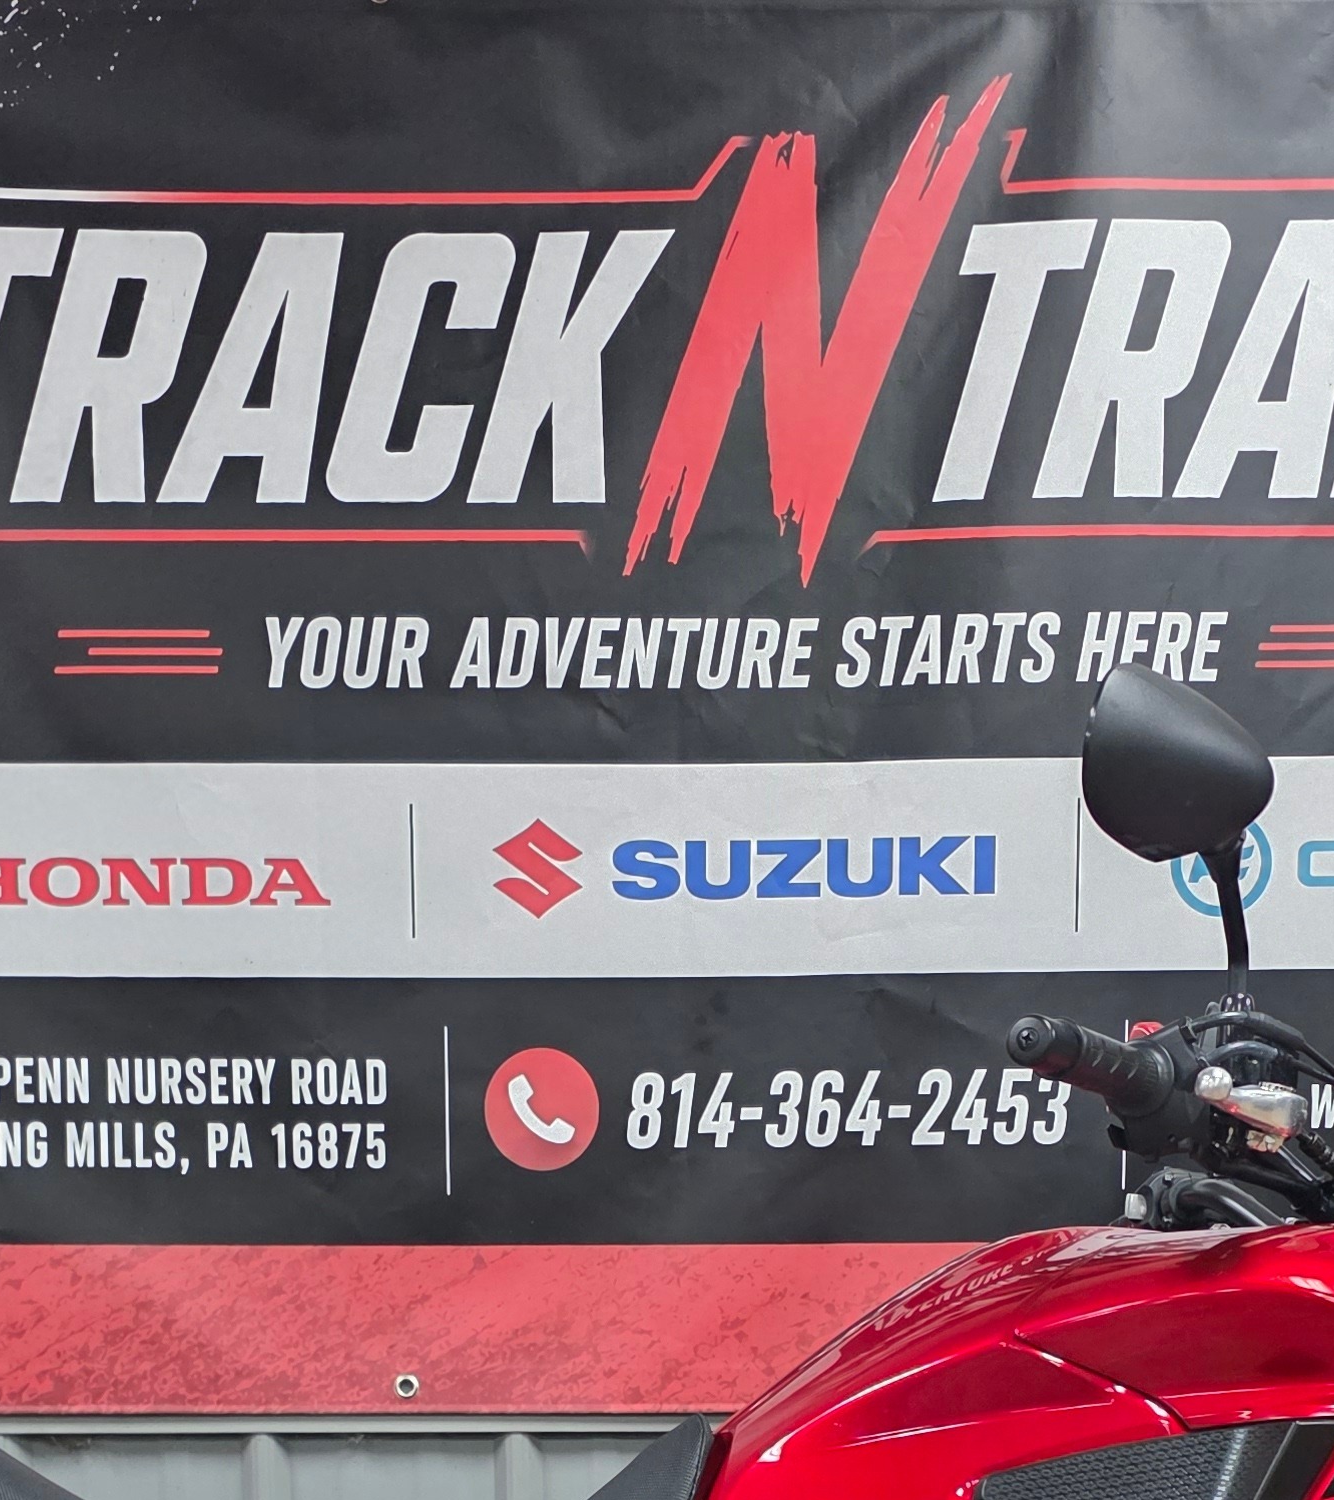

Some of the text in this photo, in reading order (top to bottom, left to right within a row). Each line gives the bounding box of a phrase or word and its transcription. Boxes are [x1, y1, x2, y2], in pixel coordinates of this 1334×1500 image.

[622, 74, 1013, 588] N
[266, 611, 1229, 691] YOUR ADVENTURE STARTS HERE
[611, 835, 997, 900] SUZUKI
[107, 1058, 276, 1106] NURSERY
[291, 1059, 388, 1106] ROAD
[626, 1067, 1072, 1151] 814-364-2453
[66, 1120, 190, 1175] MILLS,
[207, 1122, 252, 1168] PA
[271, 1123, 387, 1169] 16875
